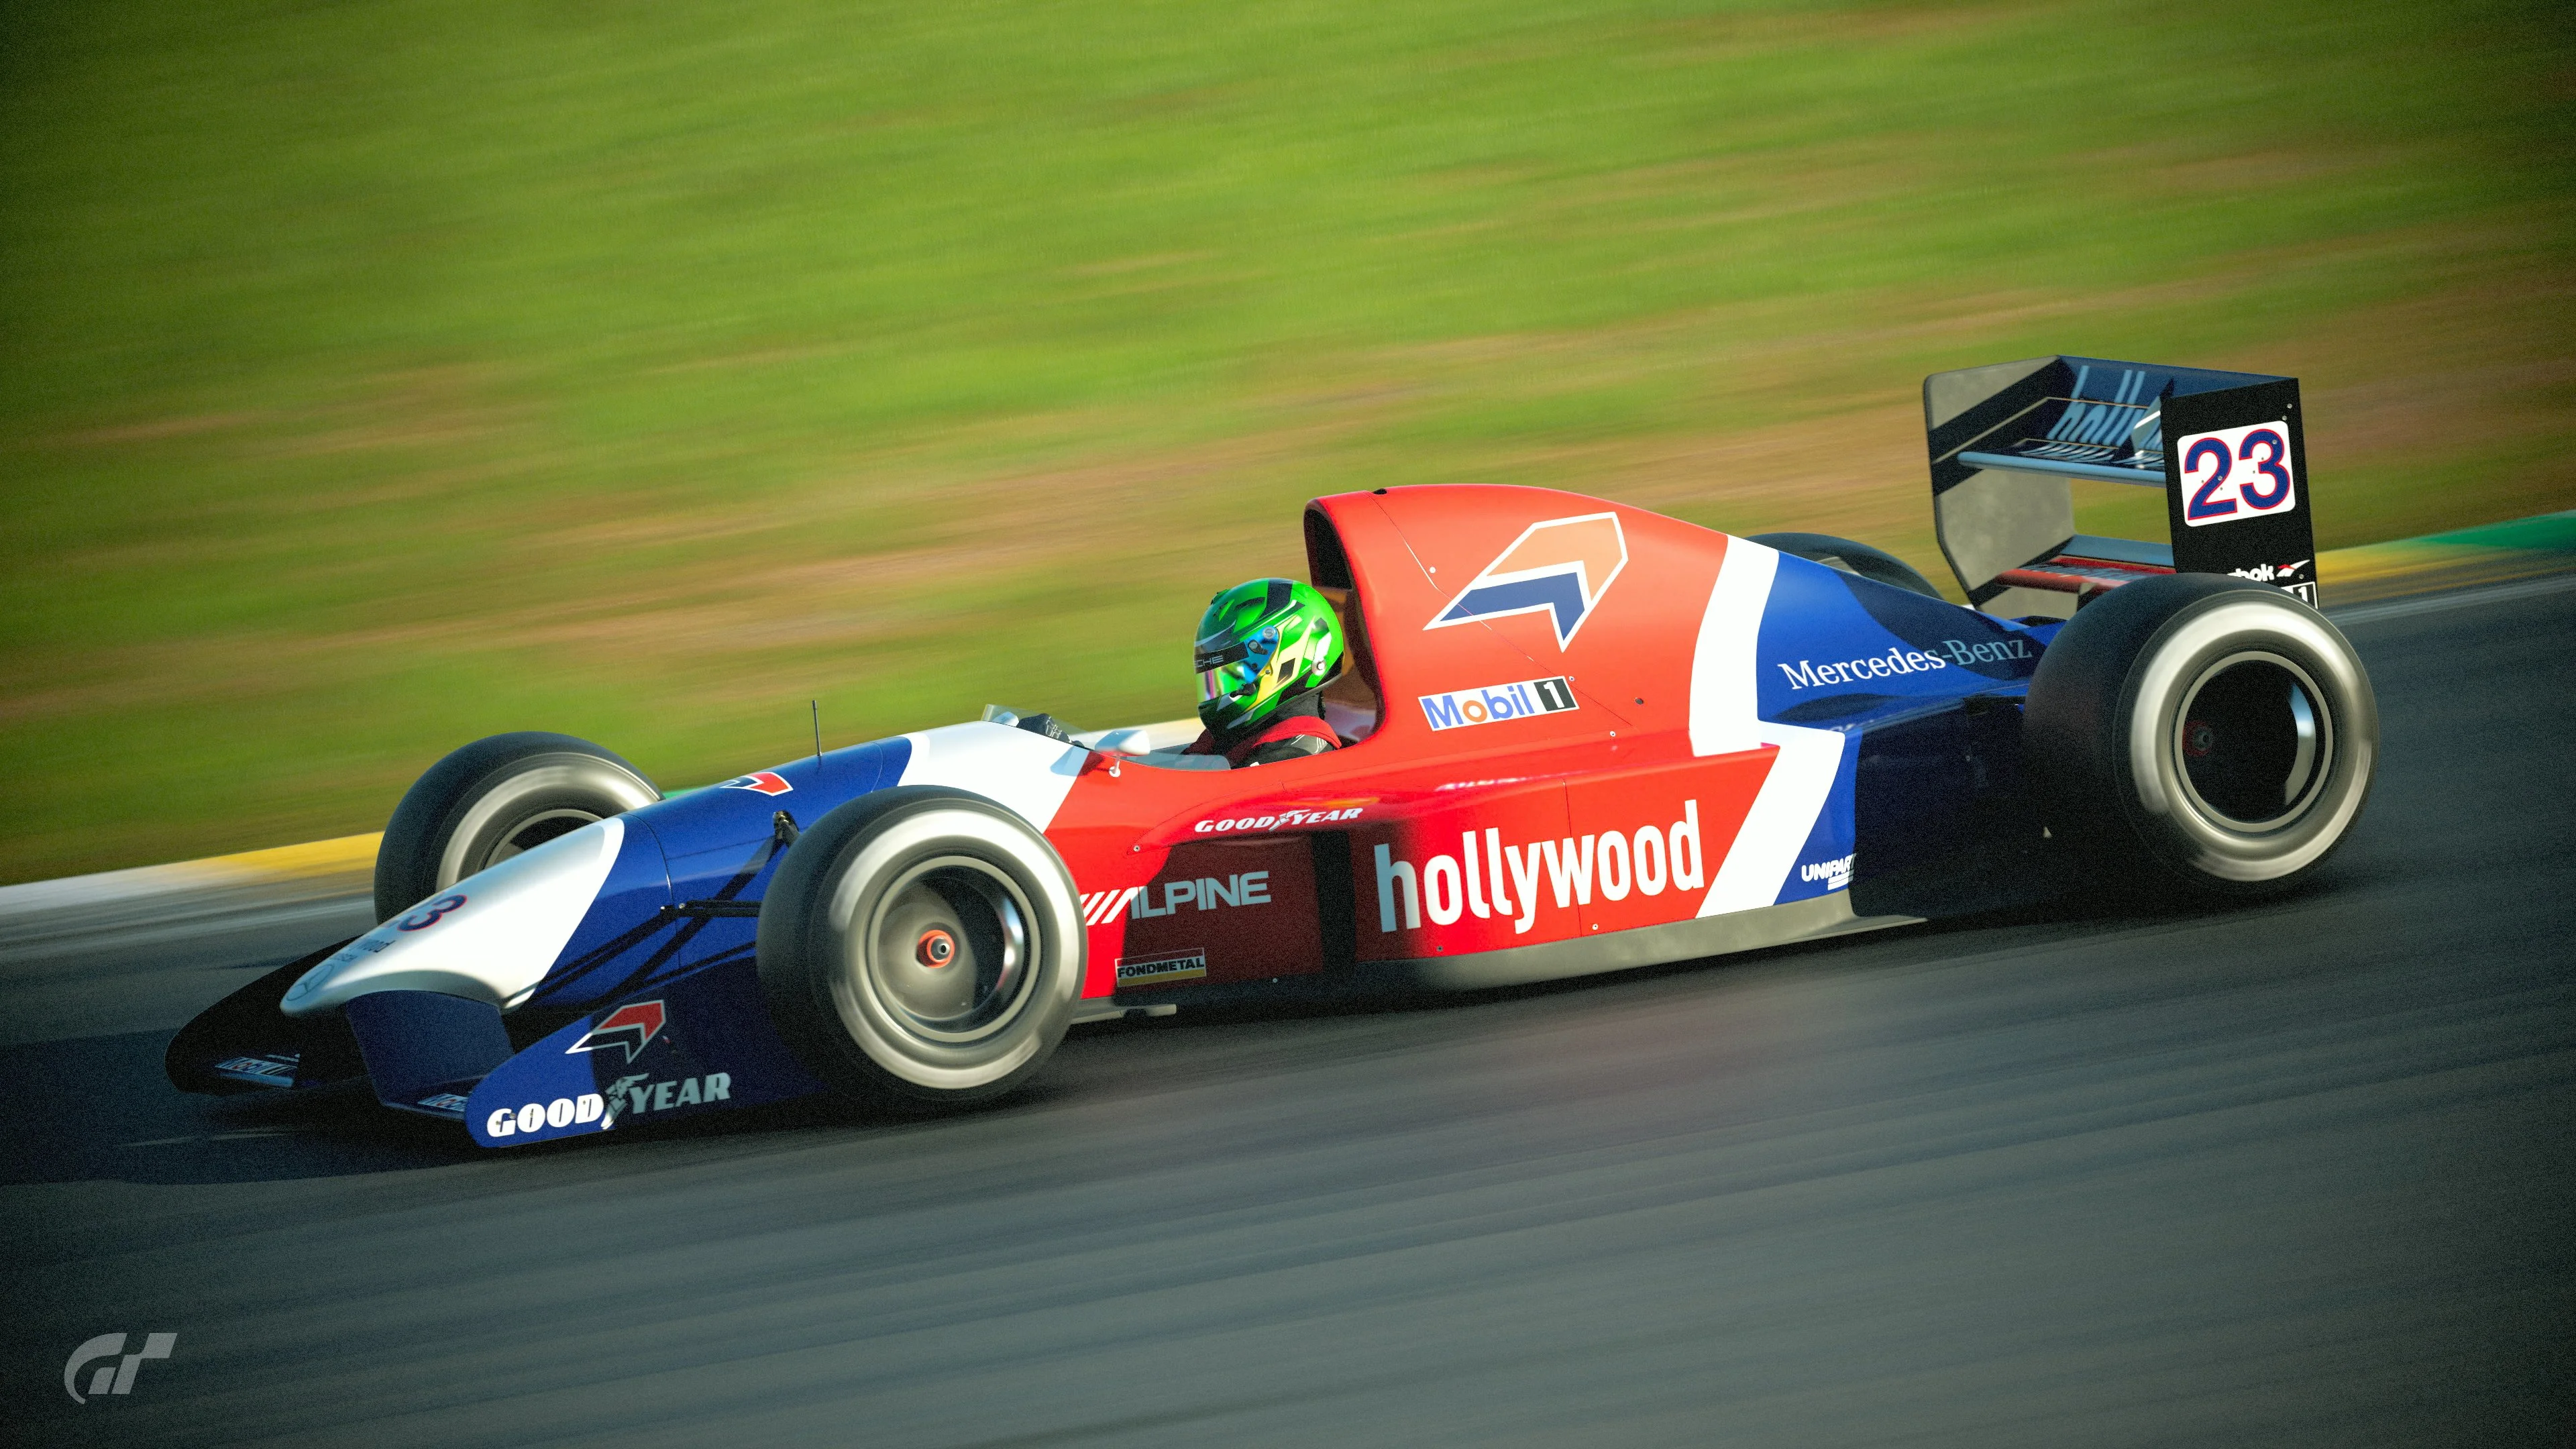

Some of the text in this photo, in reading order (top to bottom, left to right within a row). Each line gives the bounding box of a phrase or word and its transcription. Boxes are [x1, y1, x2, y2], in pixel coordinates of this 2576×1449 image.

[2184, 427, 2292, 521] 23
[1777, 637, 2033, 690] Mercedes-Benz
[1422, 679, 1567, 731] Mobil 1
[1373, 799, 1705, 934] hollywood
[1801, 853, 1857, 882] UNIPART
[382, 893, 468, 932] 3
[1116, 957, 1205, 979] FONDMETAL
